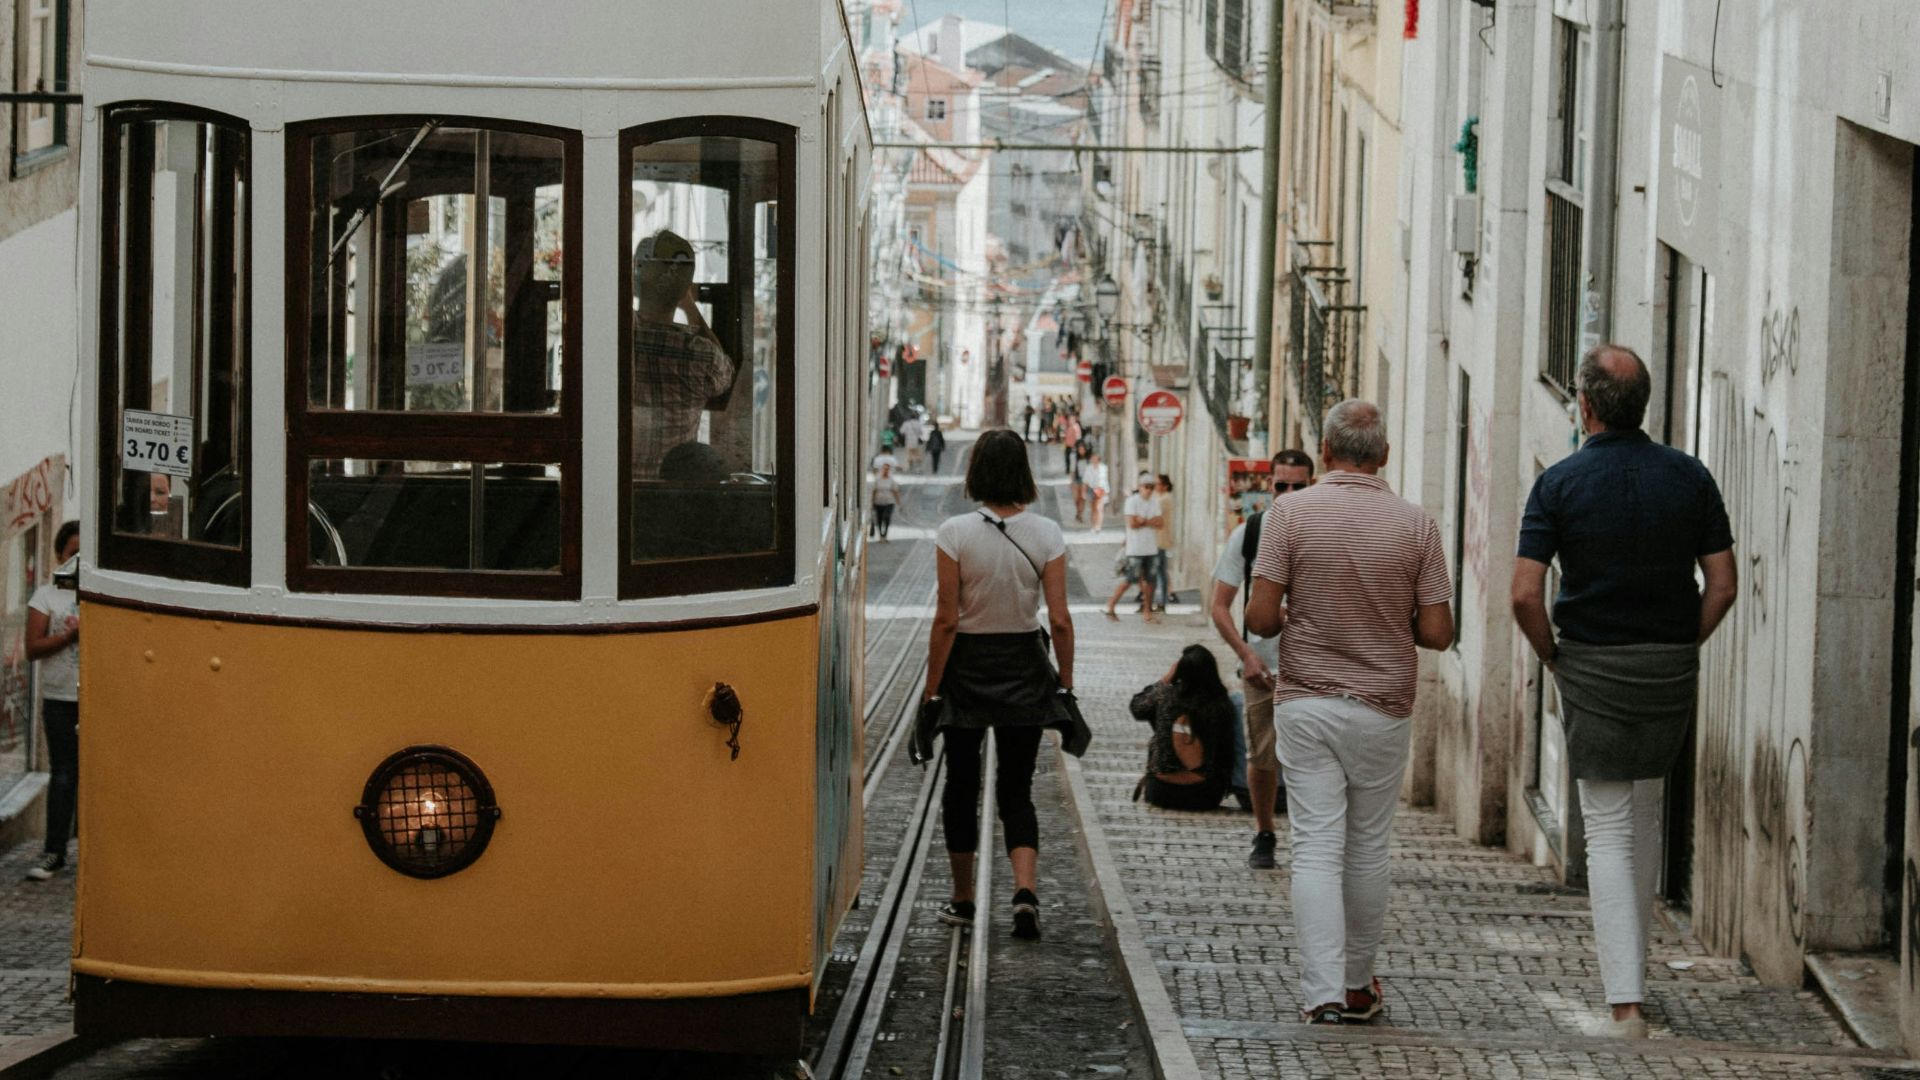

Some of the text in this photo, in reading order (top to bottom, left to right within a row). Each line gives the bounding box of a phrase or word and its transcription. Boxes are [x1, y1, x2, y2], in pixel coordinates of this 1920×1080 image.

[151, 420, 171, 428] BORDO
[134, 427, 153, 435] BOARD
[153, 429, 171, 437] TICKET
[127, 439, 189, 464] 3.70 €
